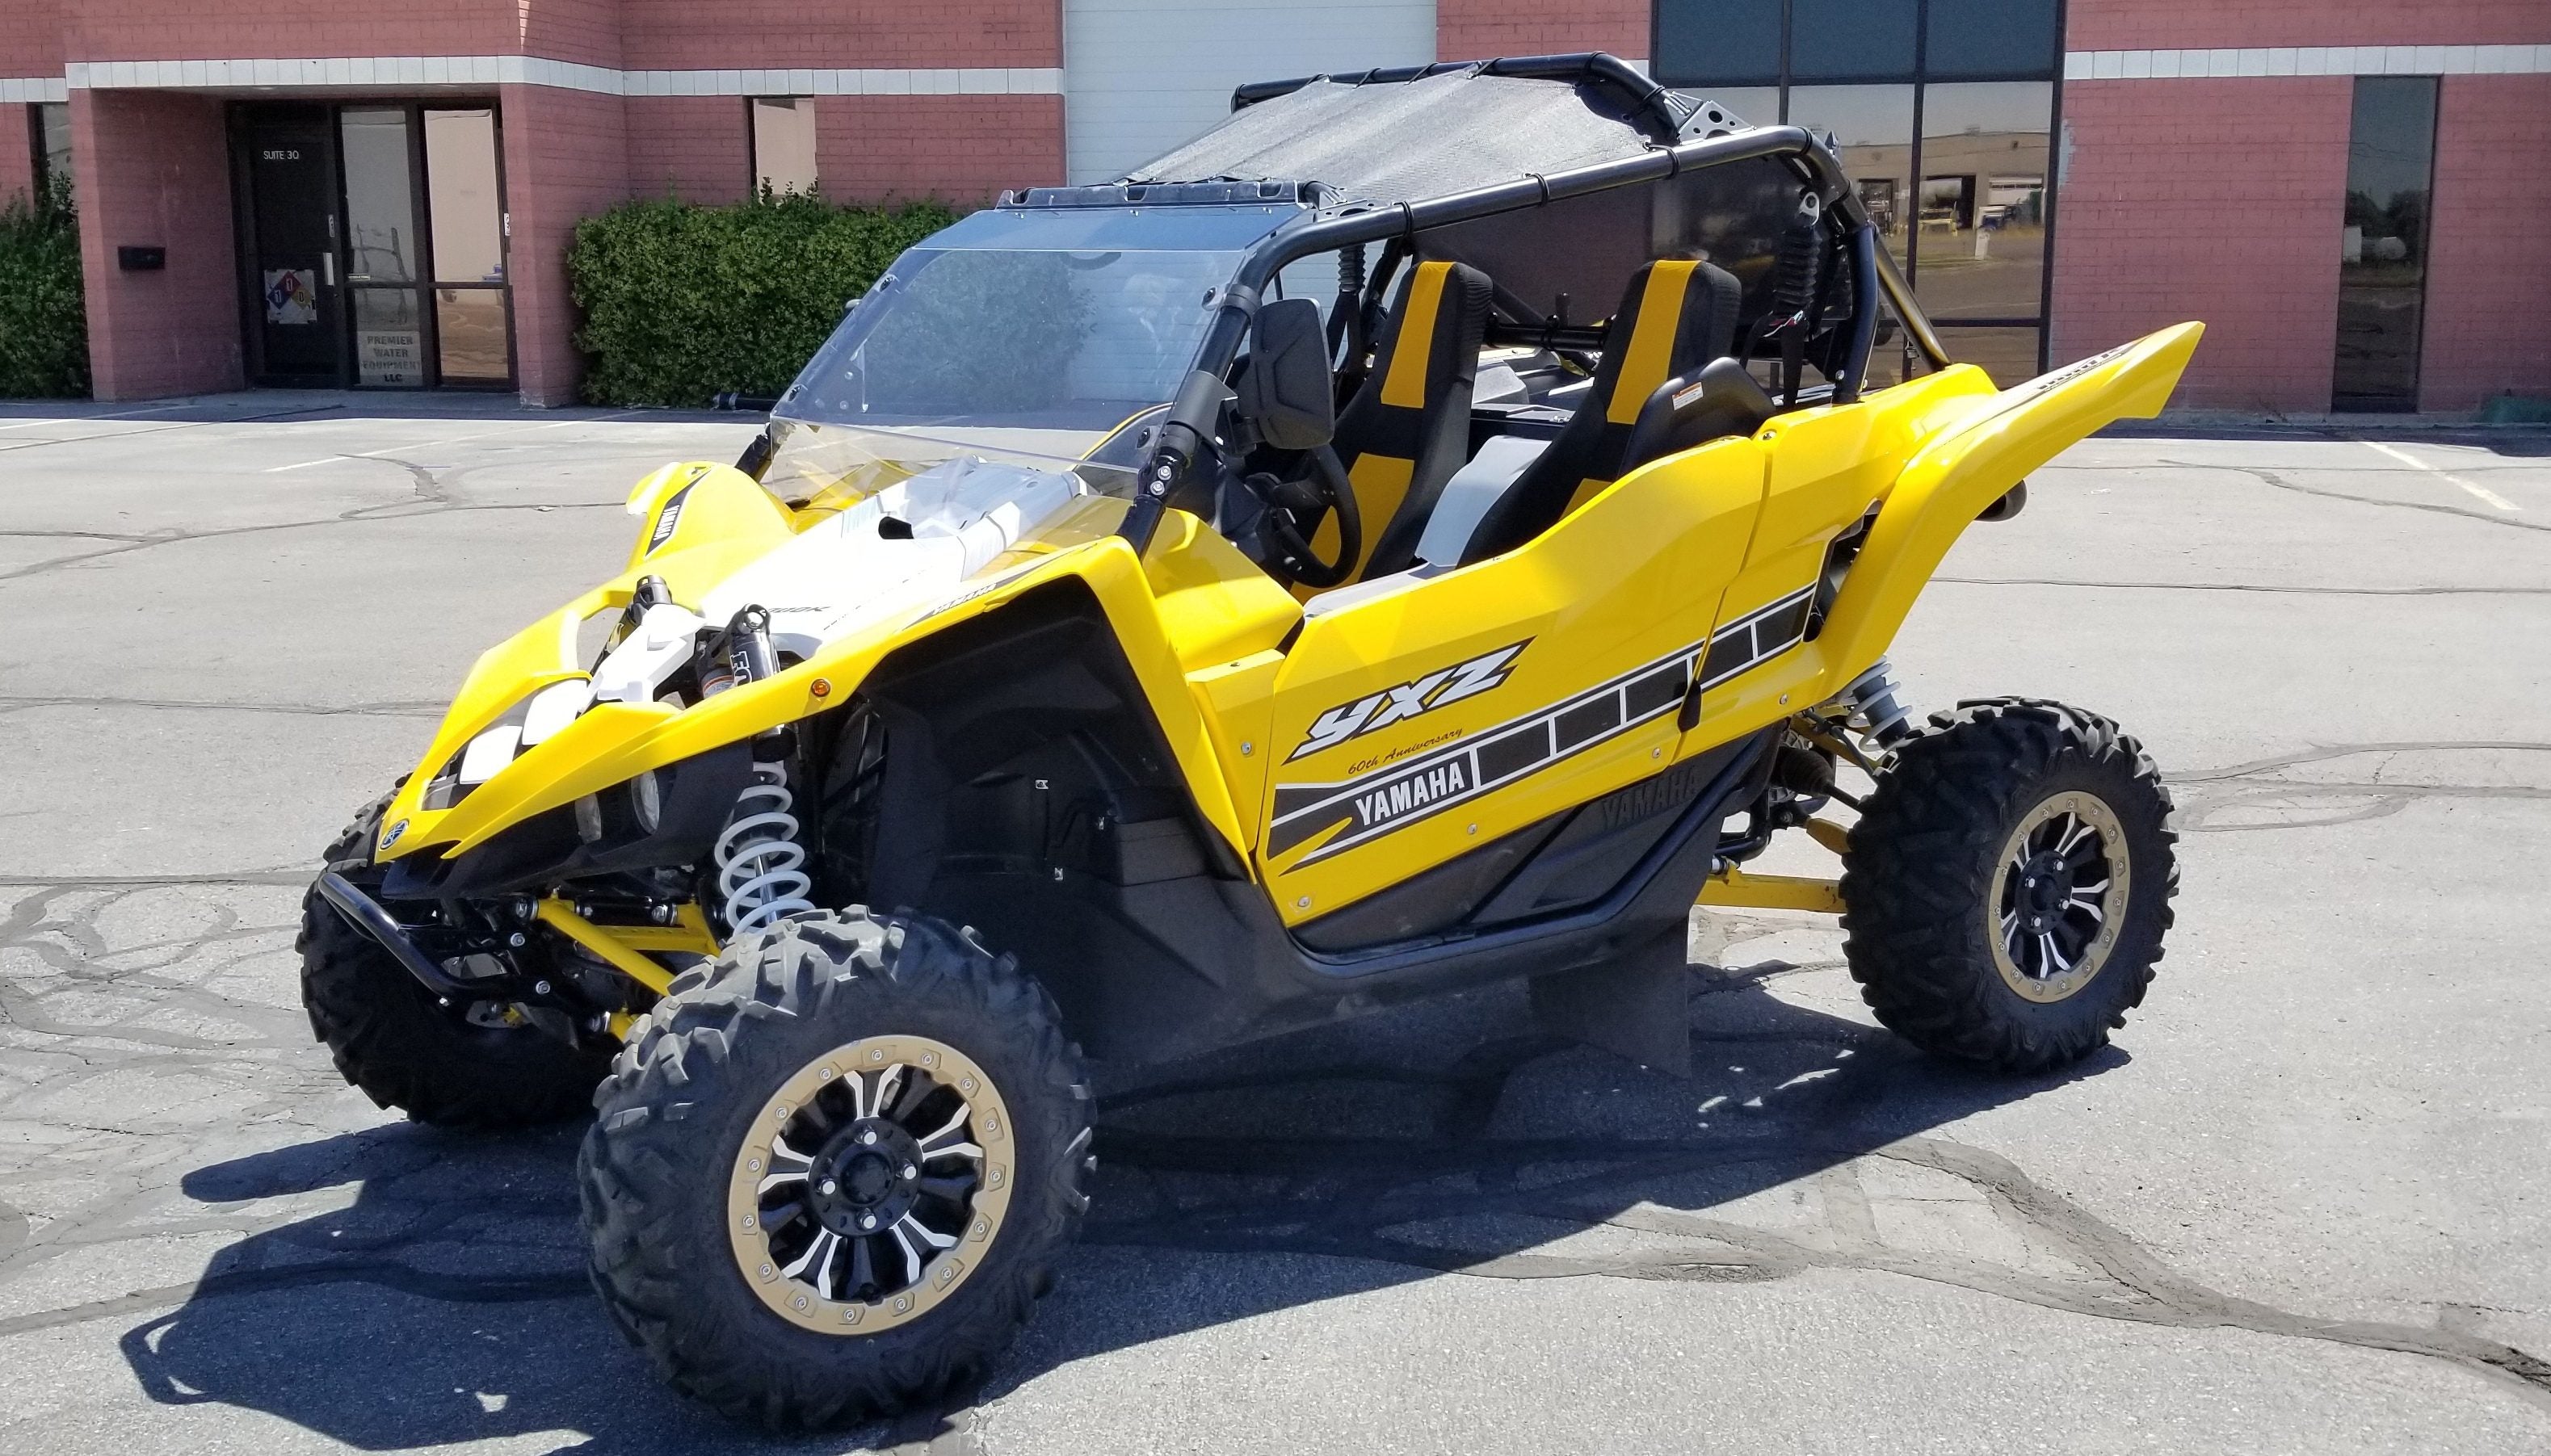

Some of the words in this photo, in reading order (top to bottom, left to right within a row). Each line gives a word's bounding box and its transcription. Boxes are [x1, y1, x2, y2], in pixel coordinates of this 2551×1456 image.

[263, 150, 284, 160] SUITE
[288, 149, 299, 160] 30
[286, 278, 293, 292] 1
[275, 289, 282, 303] 1
[368, 335, 414, 345] PREMIER
[373, 348, 408, 357] WATER
[383, 374, 402, 382] LLC
[1347, 755, 1378, 774] 60th
[1383, 728, 1463, 762] Anniversary
[1355, 762, 1465, 826] YAMAHA
[1601, 766, 1699, 831] YAMAHA
